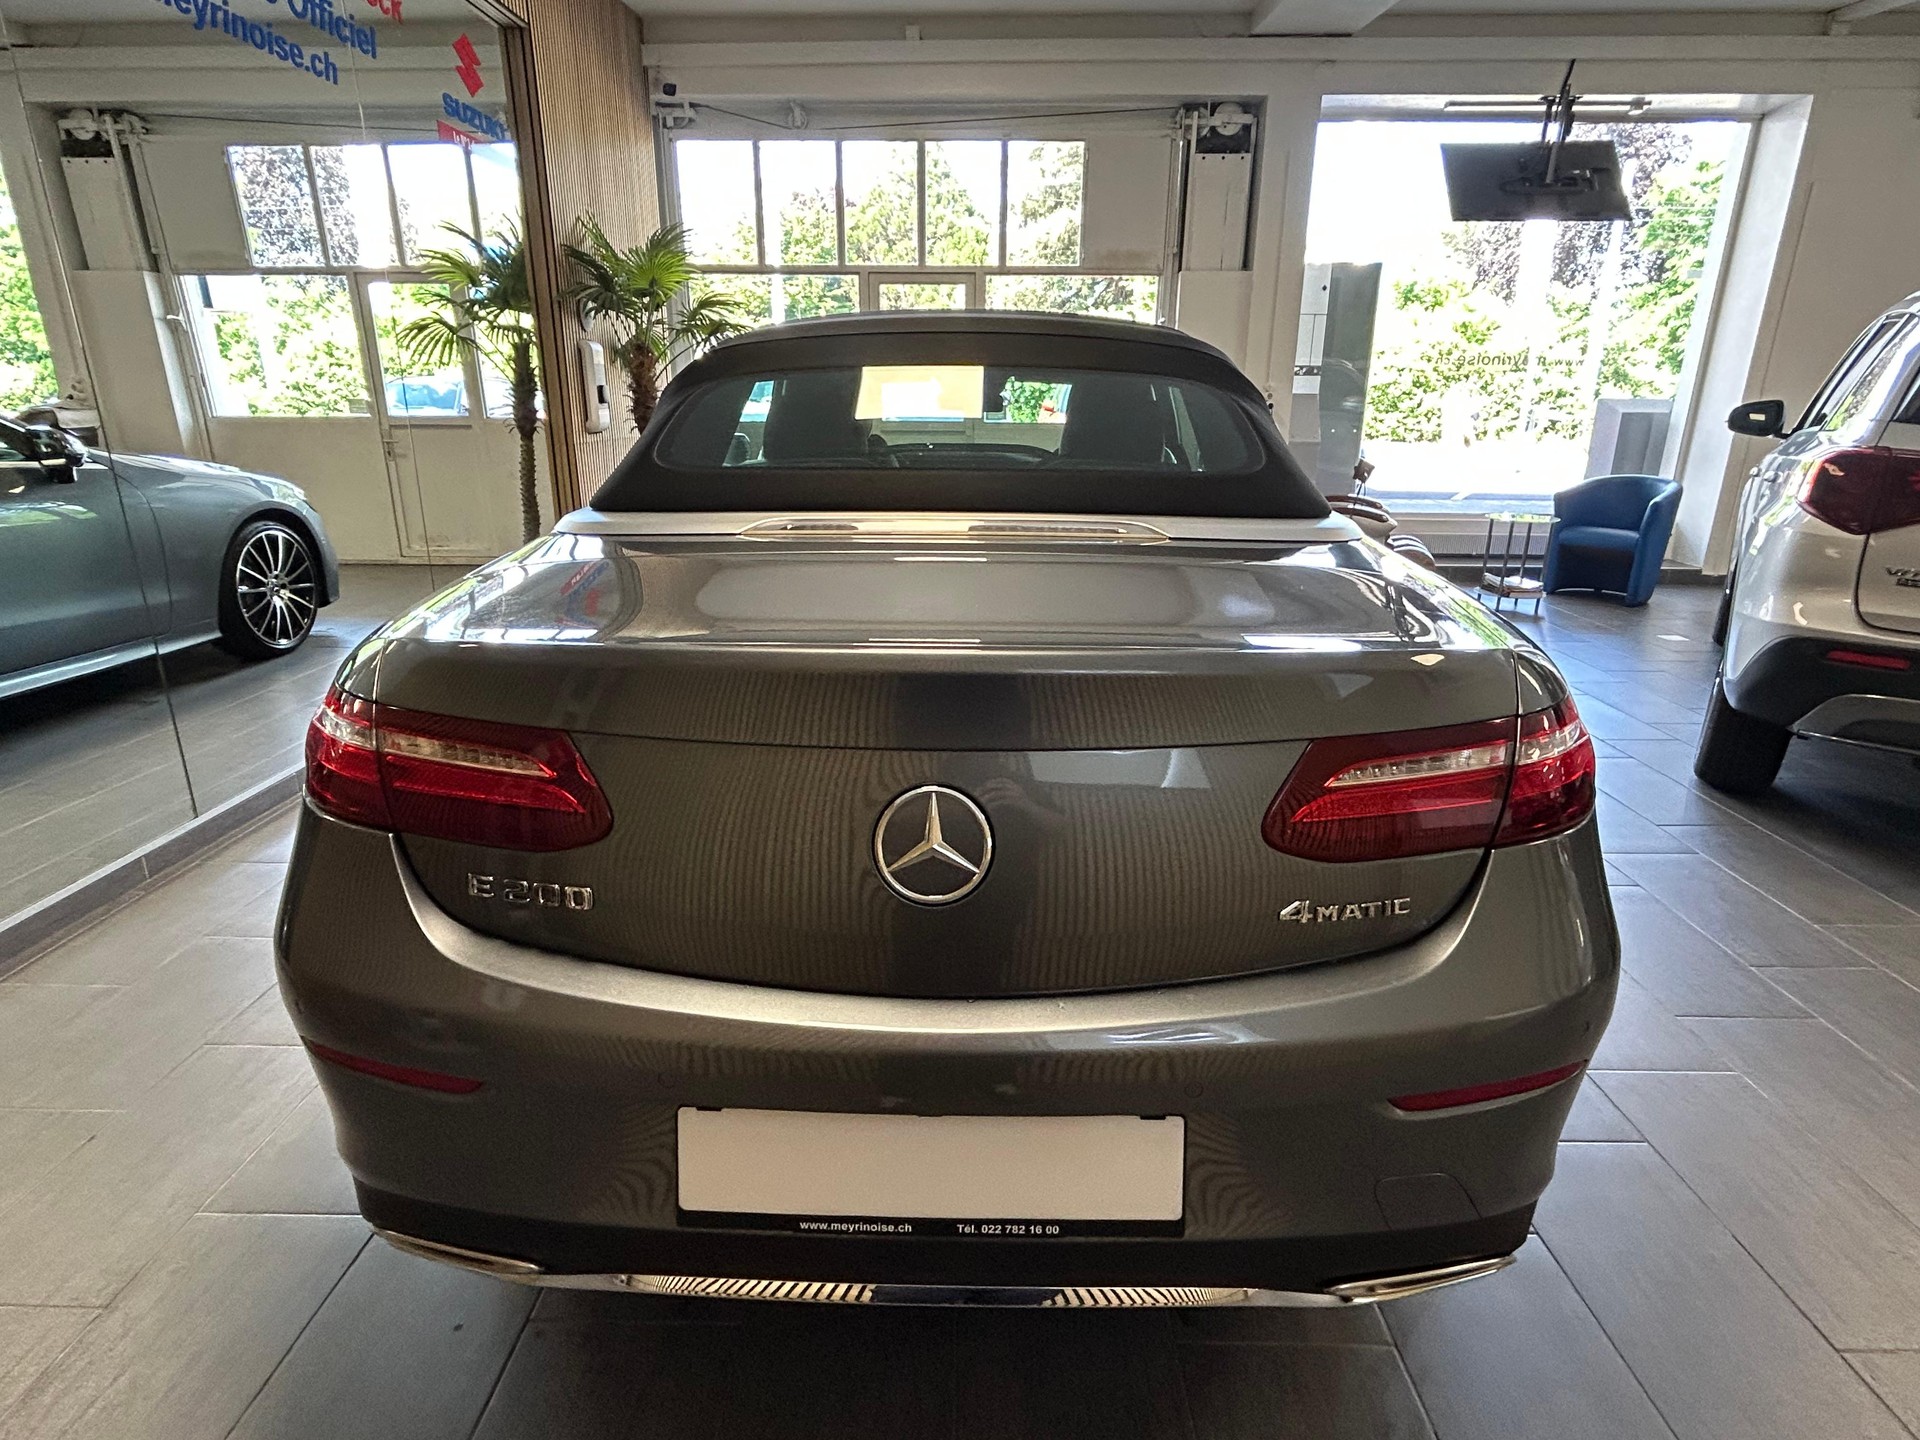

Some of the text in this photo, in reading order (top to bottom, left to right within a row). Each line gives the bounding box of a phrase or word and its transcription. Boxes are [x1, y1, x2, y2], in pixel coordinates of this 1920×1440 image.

[165, 0, 338, 85] eyrinoise.ch
[287, 0, 377, 60] Officiel
[503, 879, 593, 910] 200
[1279, 898, 1411, 924] 4MATIC
[799, 1220, 913, 1234] www.meyrinoise.ch
[956, 1223, 1060, 1235] Tél. 022 782 16 00
